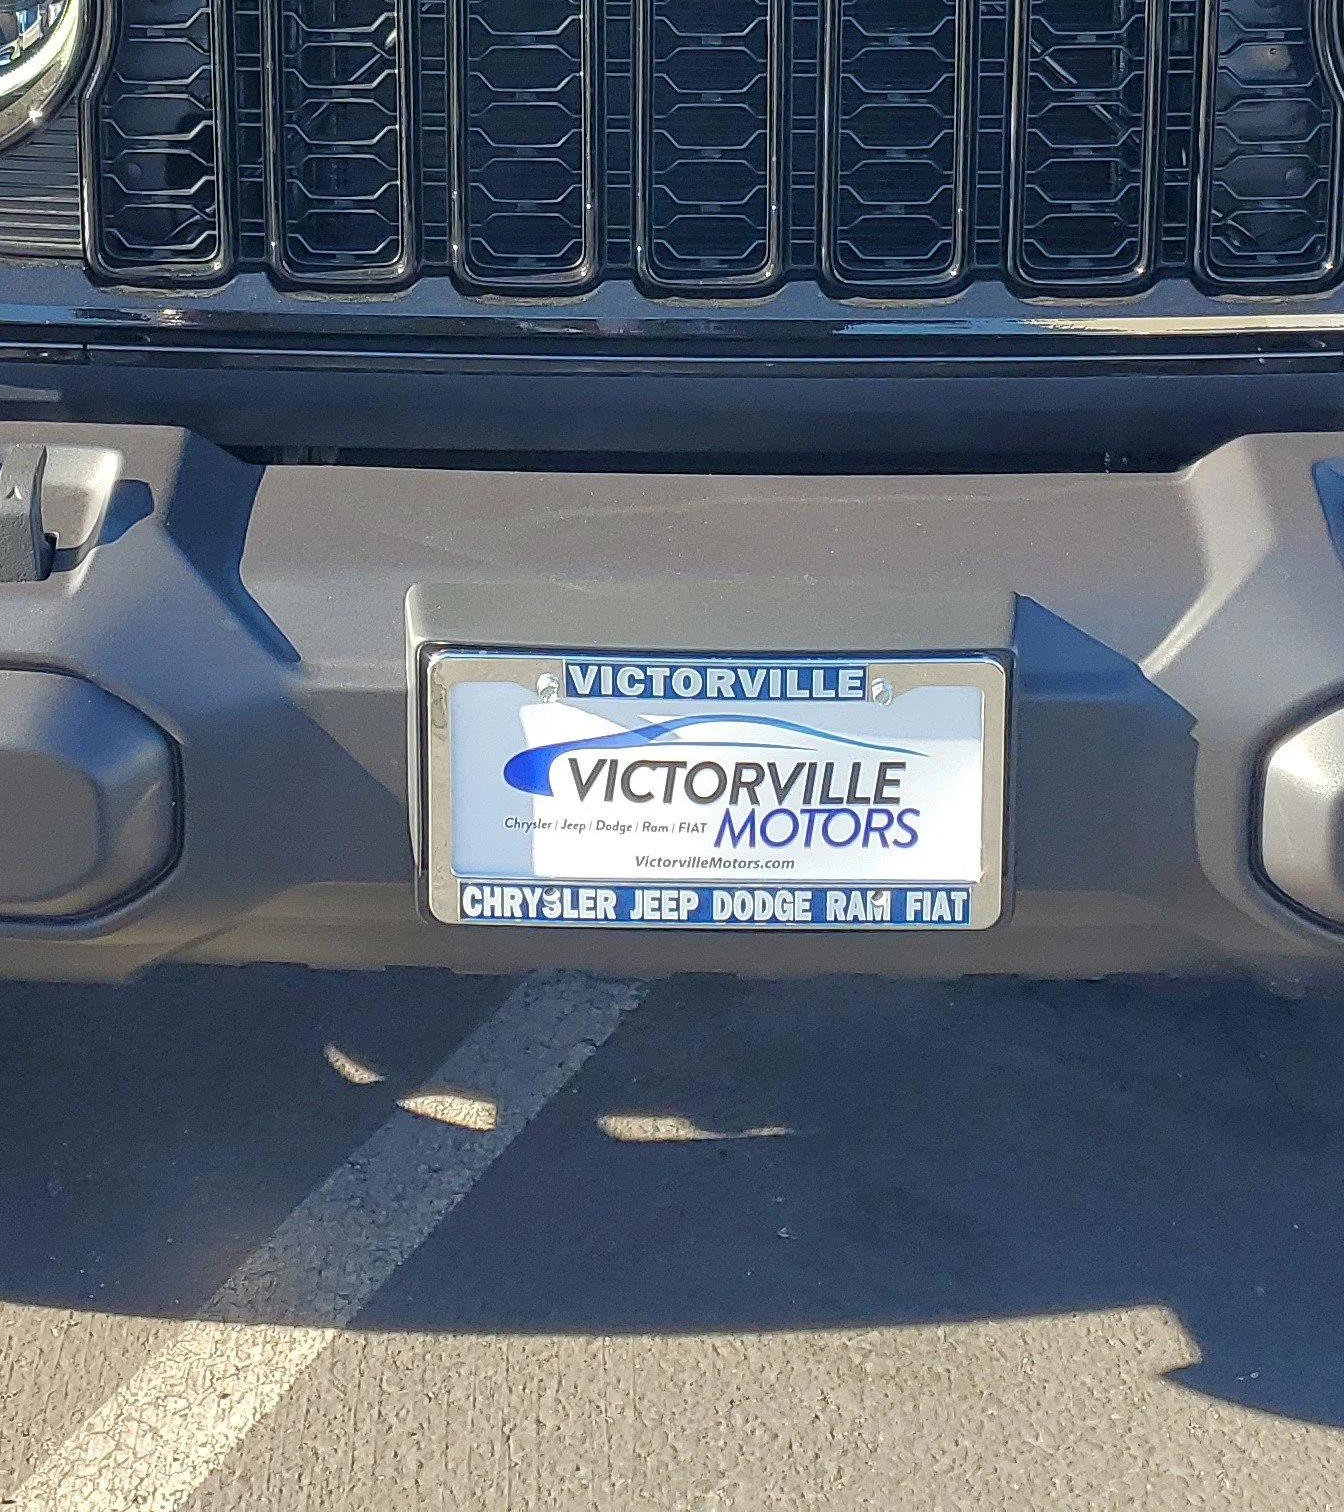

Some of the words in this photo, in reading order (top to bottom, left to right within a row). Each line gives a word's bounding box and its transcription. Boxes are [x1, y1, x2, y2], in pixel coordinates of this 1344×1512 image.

[568, 665, 864, 700] VICTORVILLE
[567, 757, 907, 805] VICTORVILLE
[504, 817, 552, 833] Chrysler
[560, 819, 586, 834] Jeep
[596, 820, 633, 835] Dodge
[642, 822, 669, 834] Ram
[678, 822, 707, 834] FIAT
[714, 806, 920, 850] MOTORS
[635, 855, 795, 870] VictorvilleMotors.com
[462, 885, 616, 922] CHRYSLER
[629, 889, 699, 922] JEEP
[712, 889, 811, 923] DODGE
[826, 889, 892, 923] RAM
[905, 890, 968, 923] FIAT
